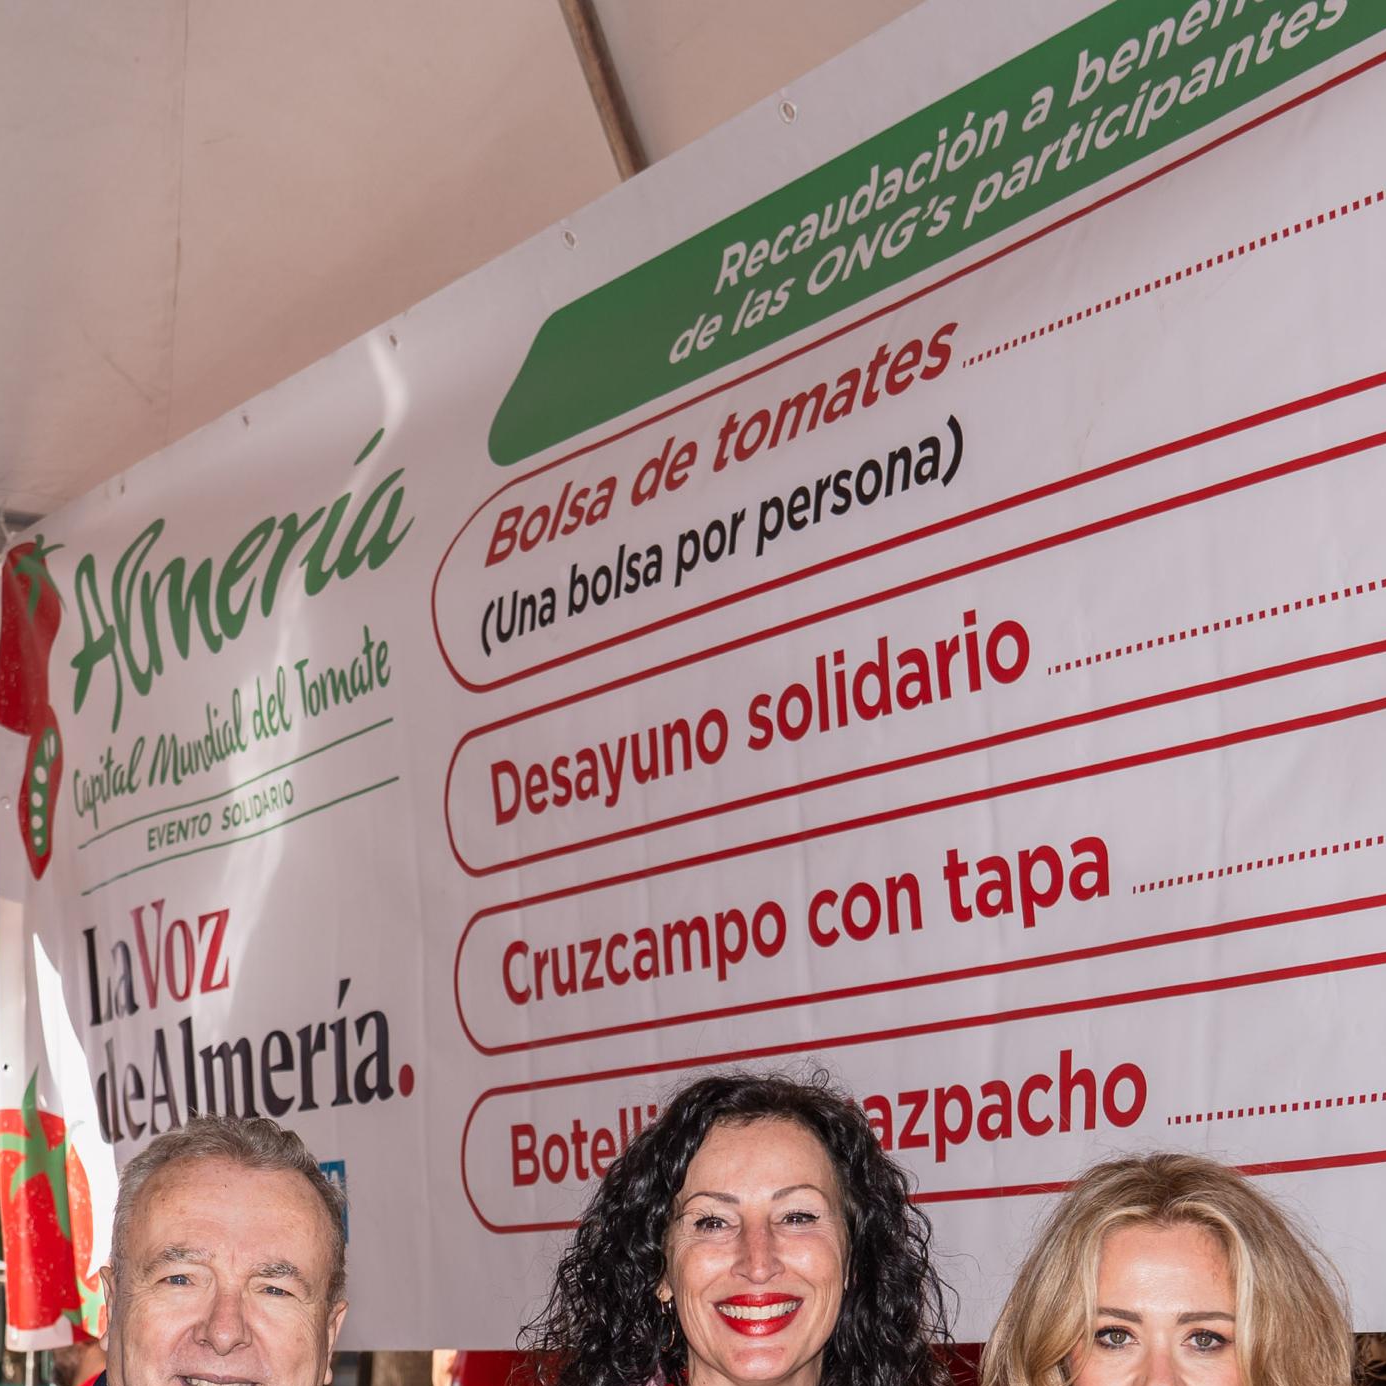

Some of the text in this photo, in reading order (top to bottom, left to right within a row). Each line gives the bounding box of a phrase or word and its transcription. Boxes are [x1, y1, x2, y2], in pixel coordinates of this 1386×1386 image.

[668, 312, 723, 365] de
[731, 277, 796, 337] las
[962, 0, 1349, 231] participantes
[713, 0, 1263, 296] Recaudación a bene
[480, 414, 965, 658] (Una bolsa por persona)
[484, 475, 618, 568] Bolsa
[630, 436, 698, 507] de
[712, 322, 959, 474] tomates
[70, 427, 415, 734] Almería
[73, 623, 392, 830] Capital Mundial del Tomate
[147, 779, 295, 852] EVENTO SOLIDARIO
[491, 708, 729, 827] Desayuno
[747, 609, 1031, 745] solidario
[501, 899, 788, 1007] Cruzcampo
[807, 872, 923, 950] con
[944, 835, 1113, 928] tapa
[853, 1049, 1149, 1163] azpacho
